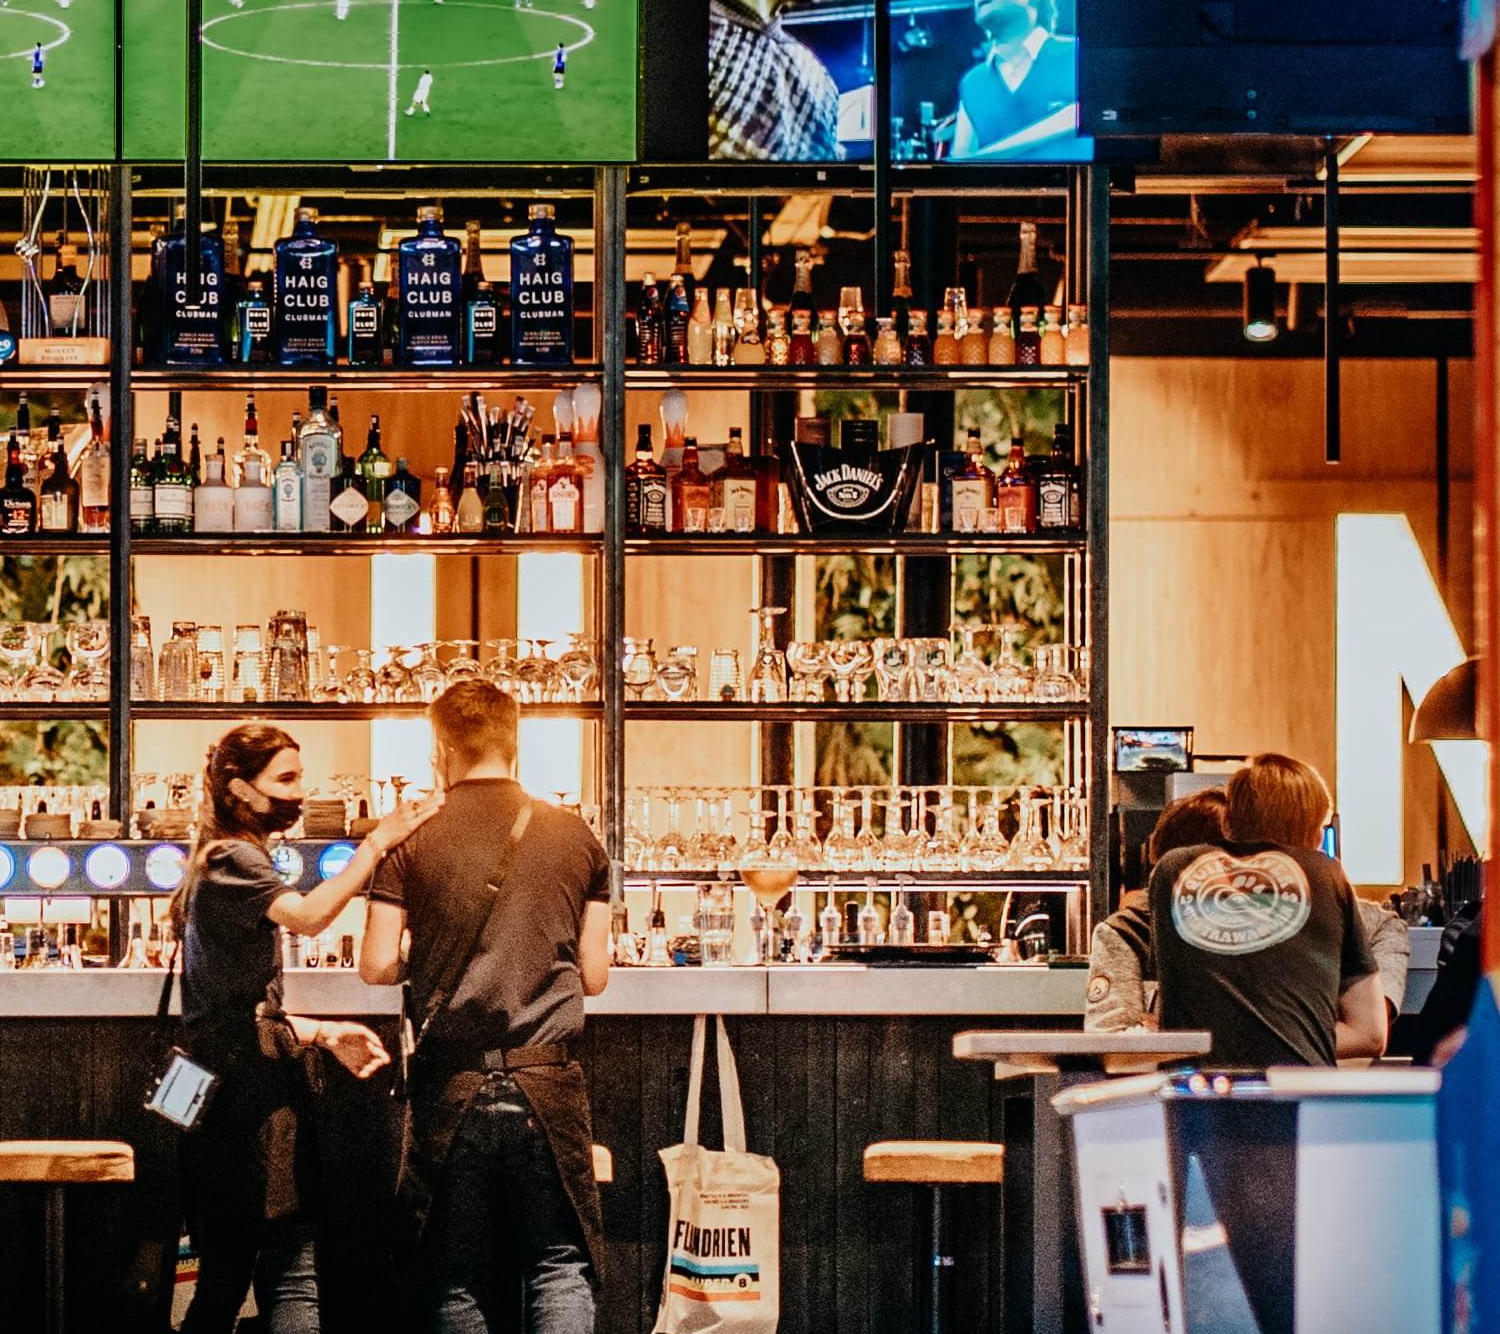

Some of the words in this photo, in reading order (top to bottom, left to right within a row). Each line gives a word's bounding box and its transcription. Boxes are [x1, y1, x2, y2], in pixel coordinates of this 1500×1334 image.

[176, 271, 218, 285] HIG
[285, 275, 329, 289] HAIG
[407, 271, 452, 285] HAIG
[519, 271, 563, 285] HAIG
[175, 290, 219, 305] CUB
[284, 294, 330, 307] CLUB
[406, 290, 453, 304] CLUB
[518, 290, 565, 304] CLUB
[175, 309, 218, 319] CLUBMAN
[284, 314, 329, 322] CLUBMAN
[407, 310, 452, 318] CLUBMAN
[519, 310, 564, 318] CLUBMAN
[814, 469, 842, 492] JACK
[841, 463, 884, 492] DANIEL'S
[11, 509, 26, 521] 12
